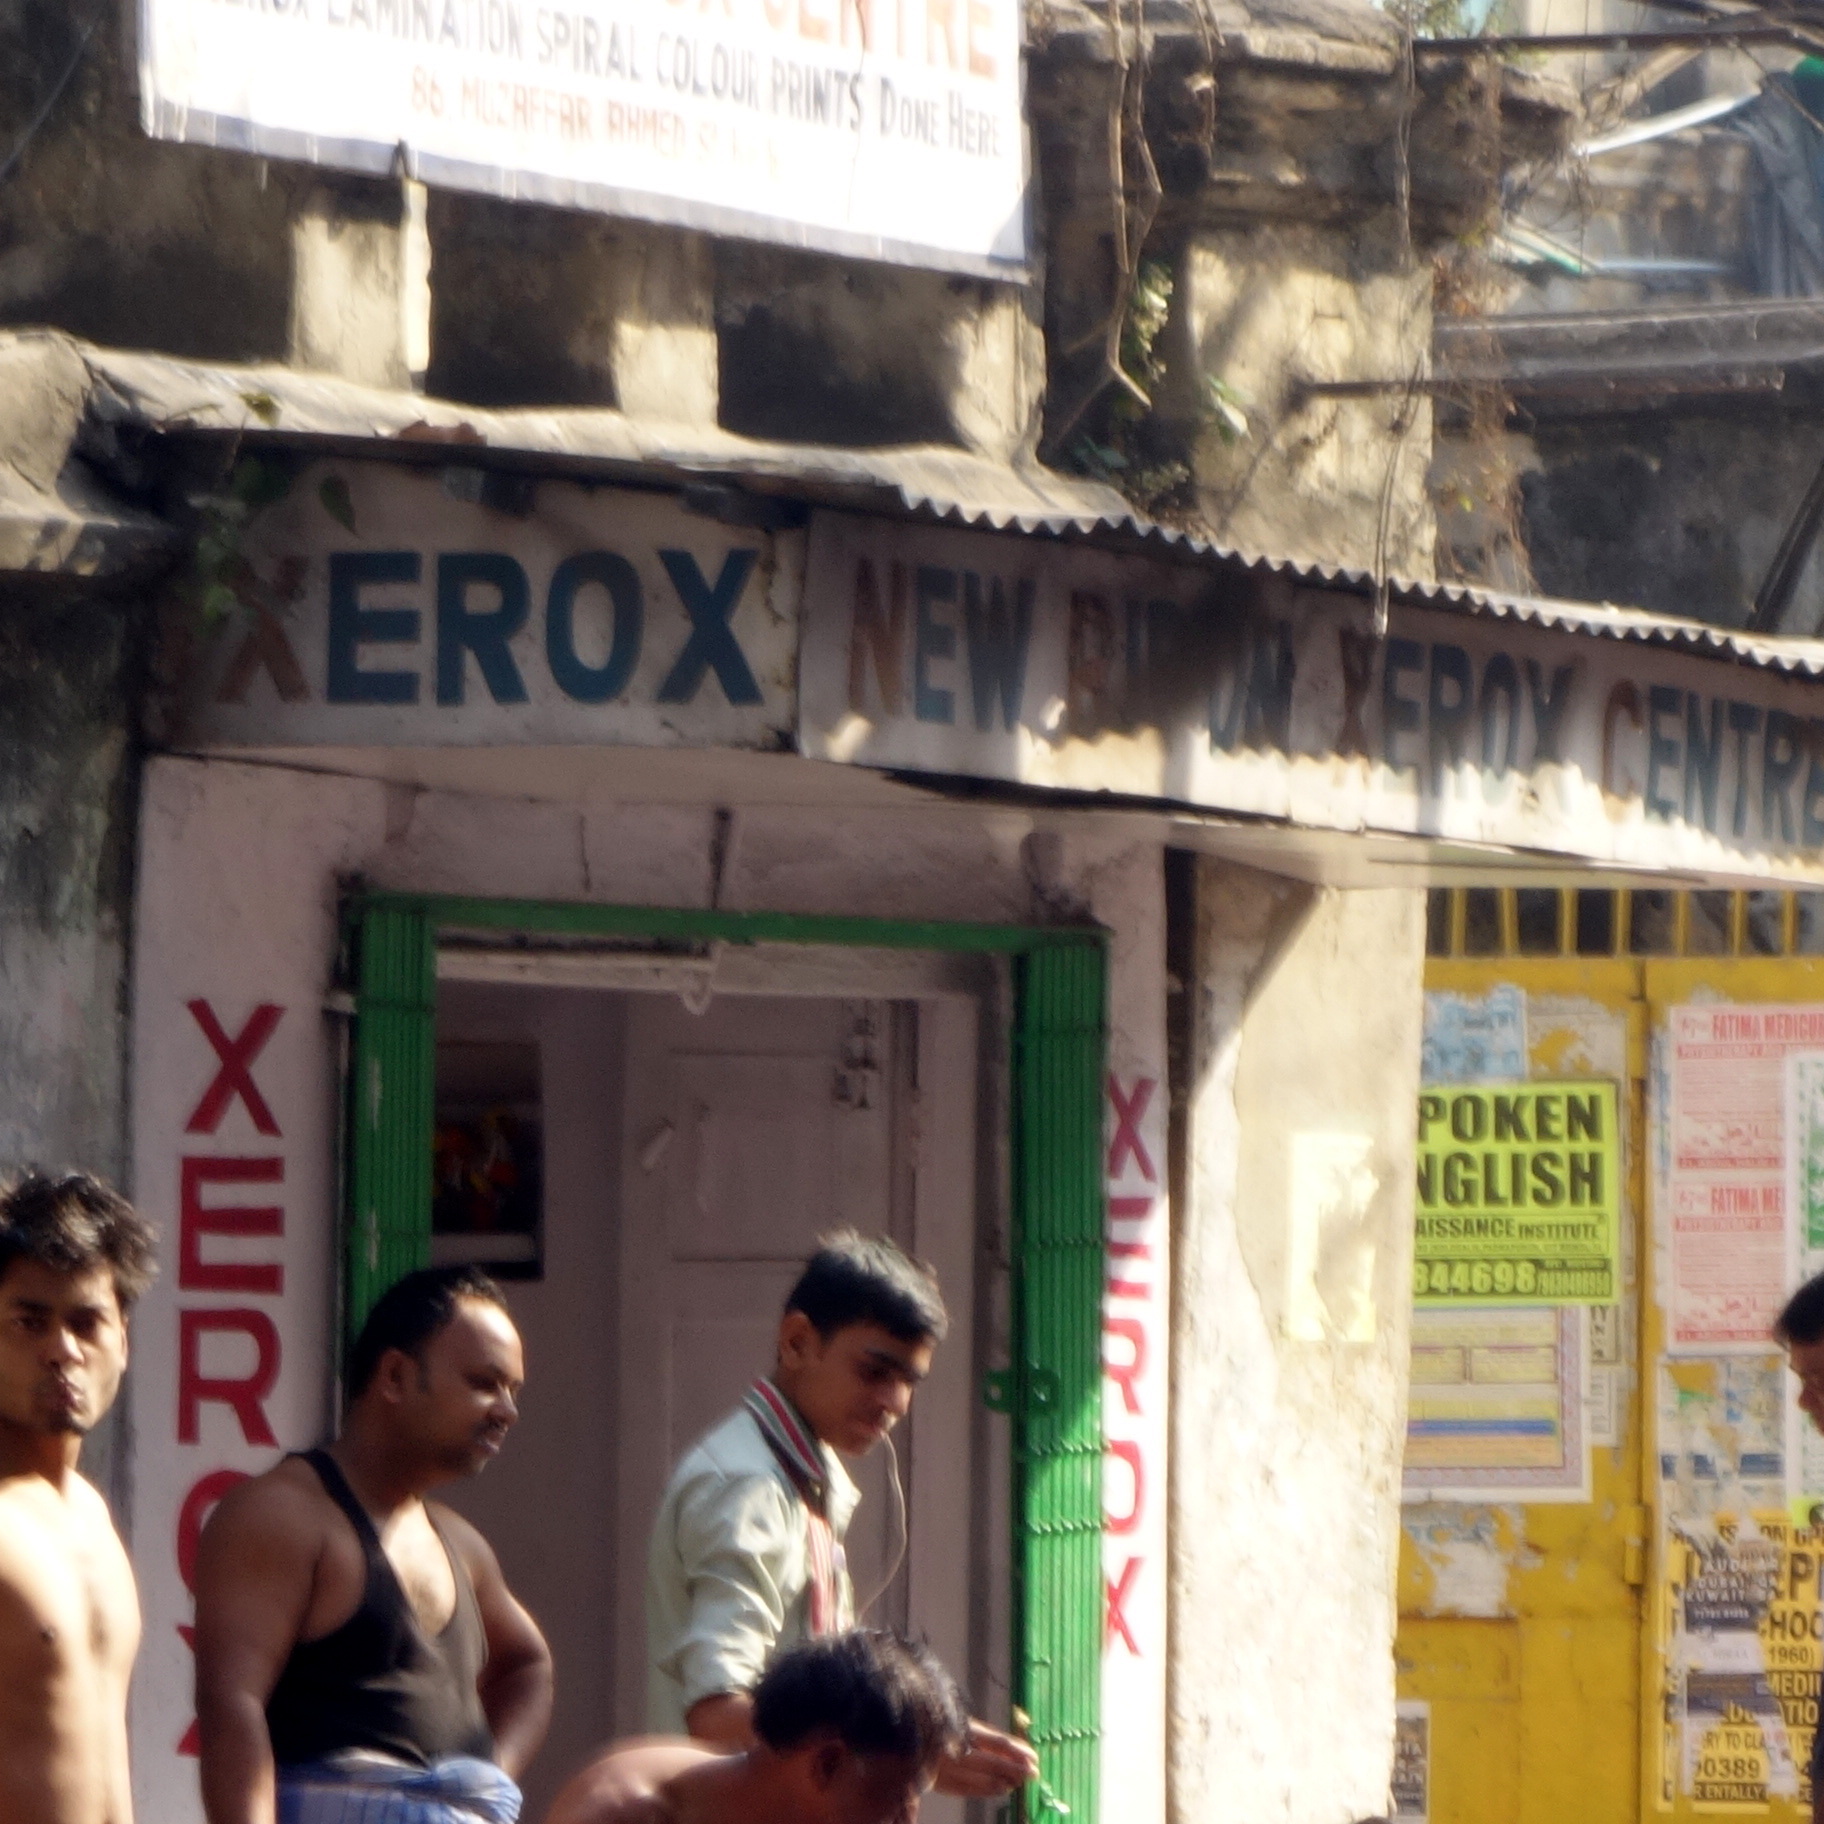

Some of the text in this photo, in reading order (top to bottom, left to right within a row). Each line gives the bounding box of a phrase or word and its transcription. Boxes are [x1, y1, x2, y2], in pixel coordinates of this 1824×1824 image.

[537, 8, 642, 84] SPIRAL
[656, 30, 760, 110] COLOUR
[770, 56, 864, 132] PRINTS
[605, 97, 687, 159] AHMED
[219, 548, 766, 706] XEROX
[848, 555, 1038, 734] NEW
[1334, 622, 1585, 800] XEROX
[1100, 1070, 1161, 1659] XEROX
